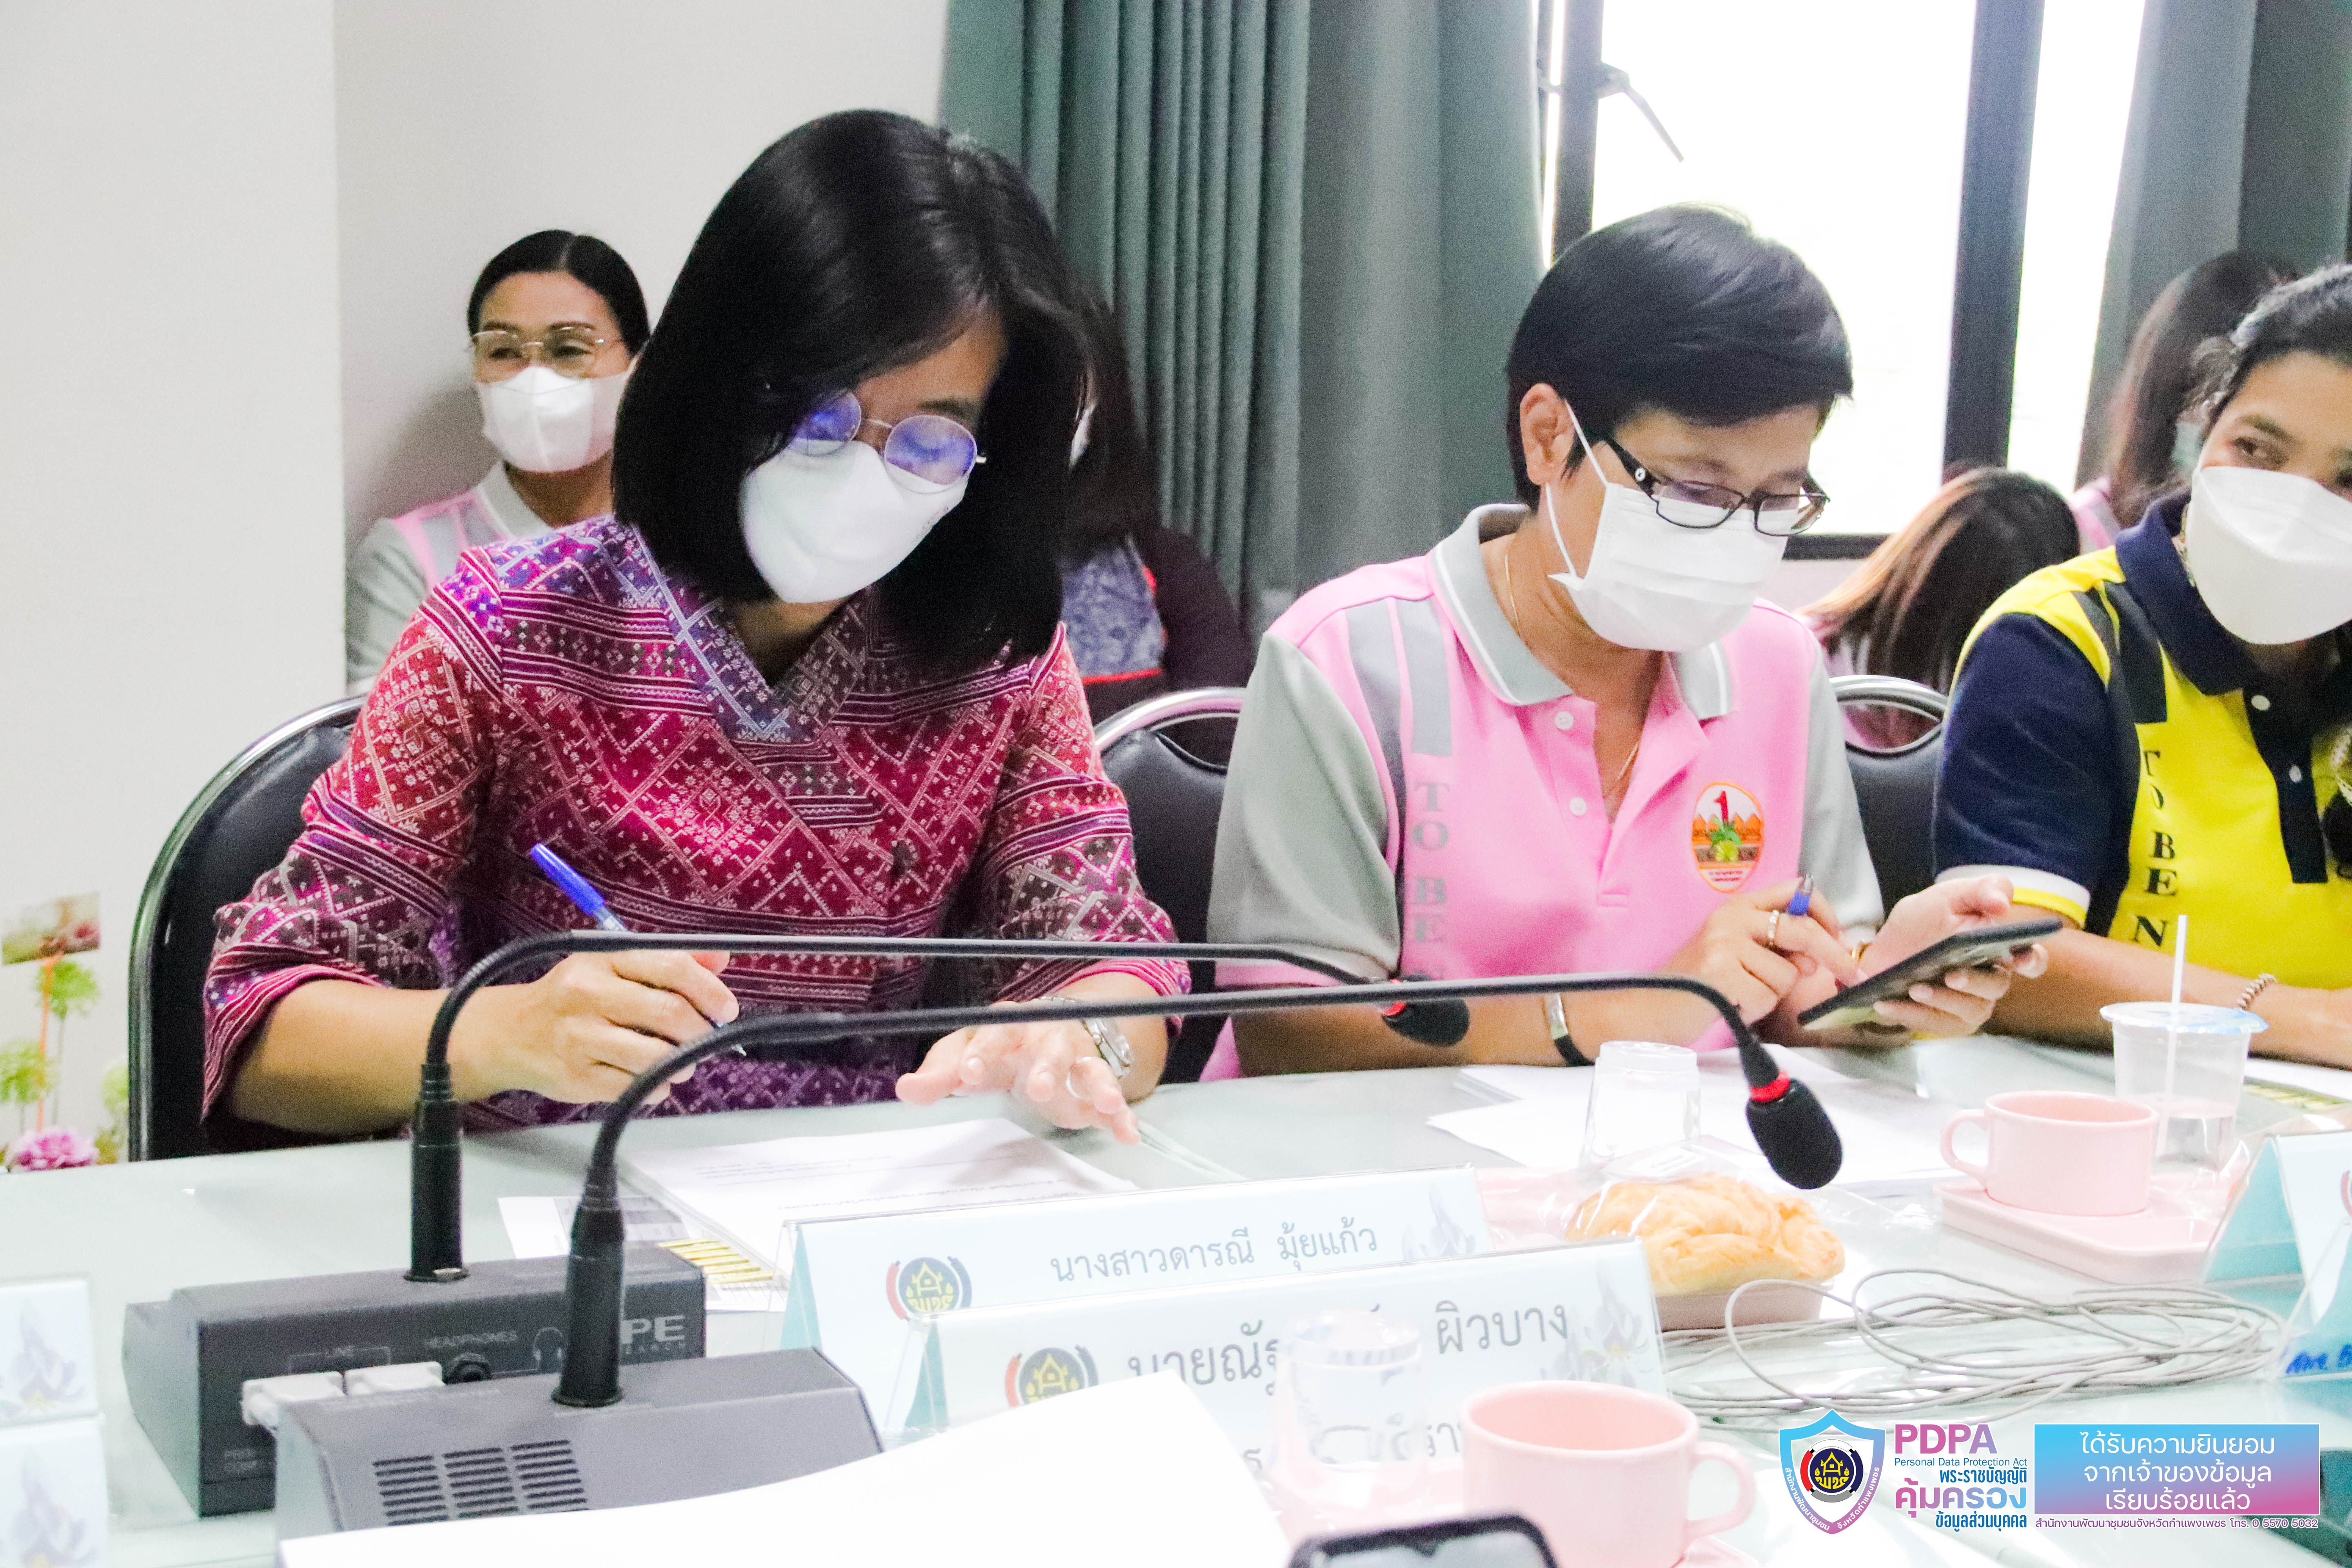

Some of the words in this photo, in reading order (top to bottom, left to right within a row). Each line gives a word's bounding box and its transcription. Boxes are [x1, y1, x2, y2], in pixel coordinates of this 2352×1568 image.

[1412, 782, 1450, 851] TO
[2146, 829, 2180, 896] BE
[1412, 875, 1447, 942] BE
[1050, 1227, 1255, 1282] นางสาวดารณี
[1277, 1216, 1377, 1271] มุ้ยแก้ว
[620, 1315, 686, 1344] PE
[1435, 1299, 1569, 1354] ผิวบาง
